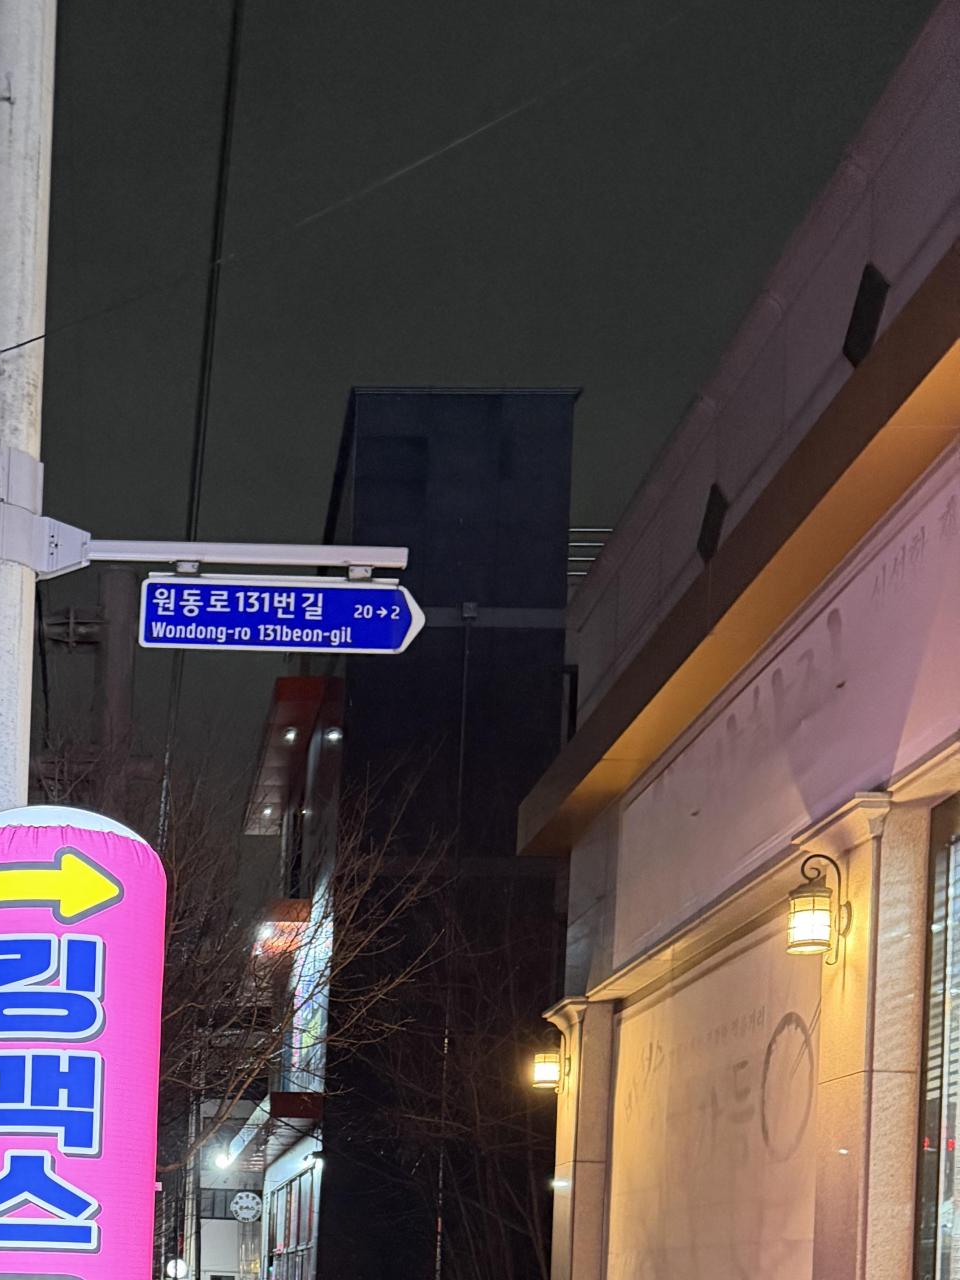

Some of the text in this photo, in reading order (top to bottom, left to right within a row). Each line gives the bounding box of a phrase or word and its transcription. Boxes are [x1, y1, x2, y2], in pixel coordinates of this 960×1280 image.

[152, 587, 324, 621] 원동로131번길
[353, 604, 401, 619] 20 2
[151, 621, 352, 646] Wondong-ro 131beon-gil
